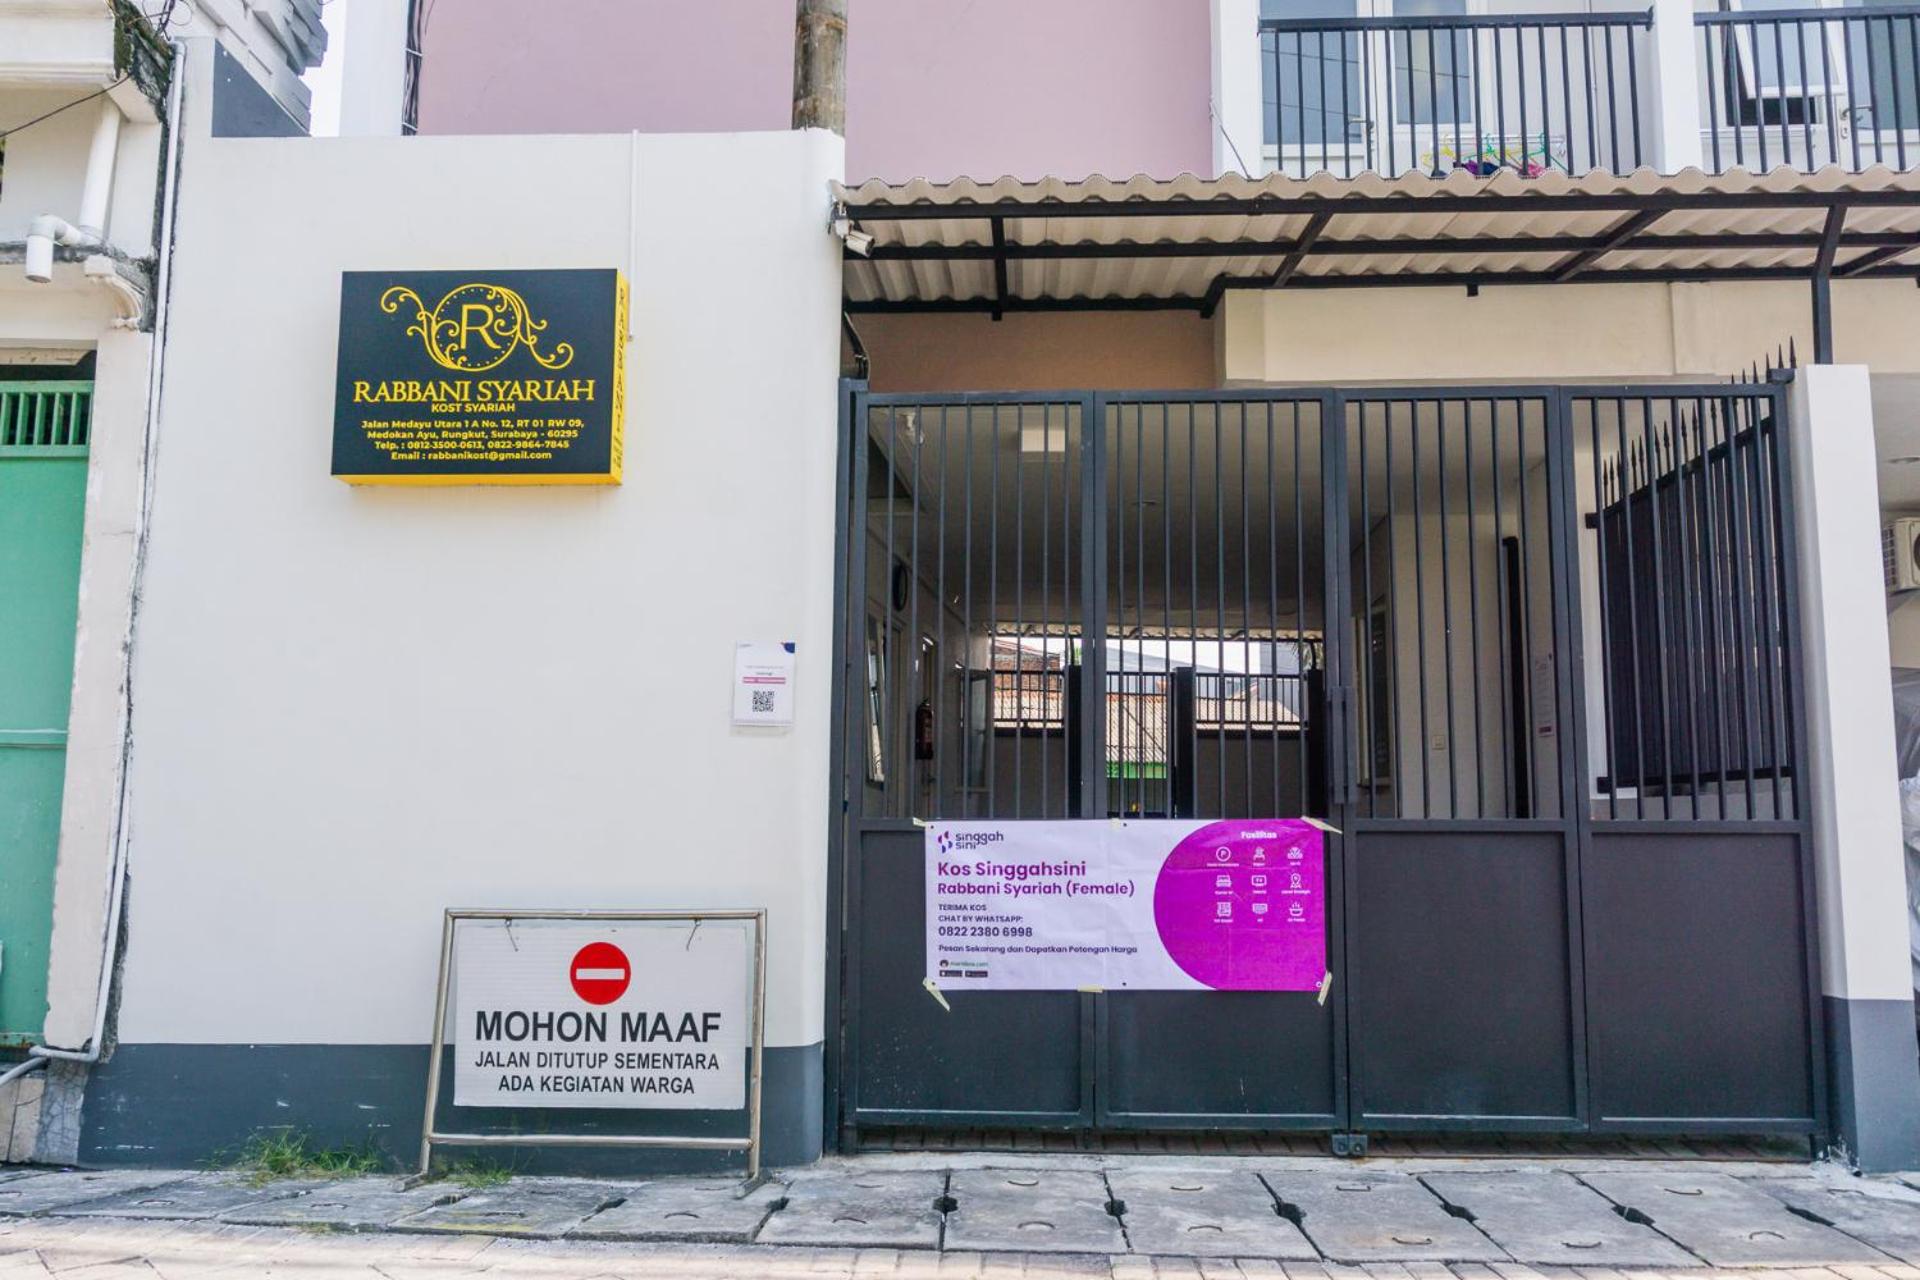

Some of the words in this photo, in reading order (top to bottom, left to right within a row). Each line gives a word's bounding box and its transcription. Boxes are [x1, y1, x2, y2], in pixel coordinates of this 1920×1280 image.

[354, 380, 471, 402] RABBANI
[477, 380, 596, 402] SYARIAH
[432, 403, 461, 412] KOST
[464, 403, 515, 412] SYARIAH
[361, 420, 389, 428] Jalan
[392, 420, 431, 430] Medayu
[434, 420, 462, 428] Utara
[471, 420, 480, 428] A
[482, 420, 498, 428] No.
[516, 420, 530, 428] RT
[532, 420, 544, 428] 01
[548, 420, 566, 428] RW
[568, 420, 584, 428] 09,
[367, 431, 414, 439] Medokan
[416, 432, 440, 440] Ayu,
[442, 430, 488, 440] Rungkut,
[491, 430, 538, 440] Surabaya
[547, 430, 578, 438] 60295
[374, 441, 399, 450] Telp.
[391, 452, 420, 460] Email
[428, 451, 552, 461] rabbanikost@gmail.com
[956, 832, 1004, 845] singgah
[956, 842, 976, 850] sini
[938, 862, 971, 876] Kos
[976, 861, 1086, 880] Singgahsini
[938, 882, 1000, 894] Rabbani
[1004, 882, 1062, 898] Syariah
[1066, 880, 1135, 898] (Female)
[938, 926, 968, 936] 0822
[970, 926, 1000, 937] 2380
[1002, 927, 1033, 937] 6998
[966, 946, 1006, 954] Sekarang
[1025, 946, 1068, 954] Dapatkan
[1069, 946, 1110, 954] Potongan
[1111, 946, 1138, 954] Harga
[475, 1010, 607, 1042] MOHON
[620, 1012, 721, 1043] MAAF
[475, 1051, 530, 1068] JALAN
[536, 1052, 608, 1069] DITUTUP
[614, 1053, 720, 1070] SEMENTARA
[498, 1075, 535, 1092] ADA
[540, 1076, 624, 1093] KEGIATAN
[630, 1076, 695, 1094] WARGA
